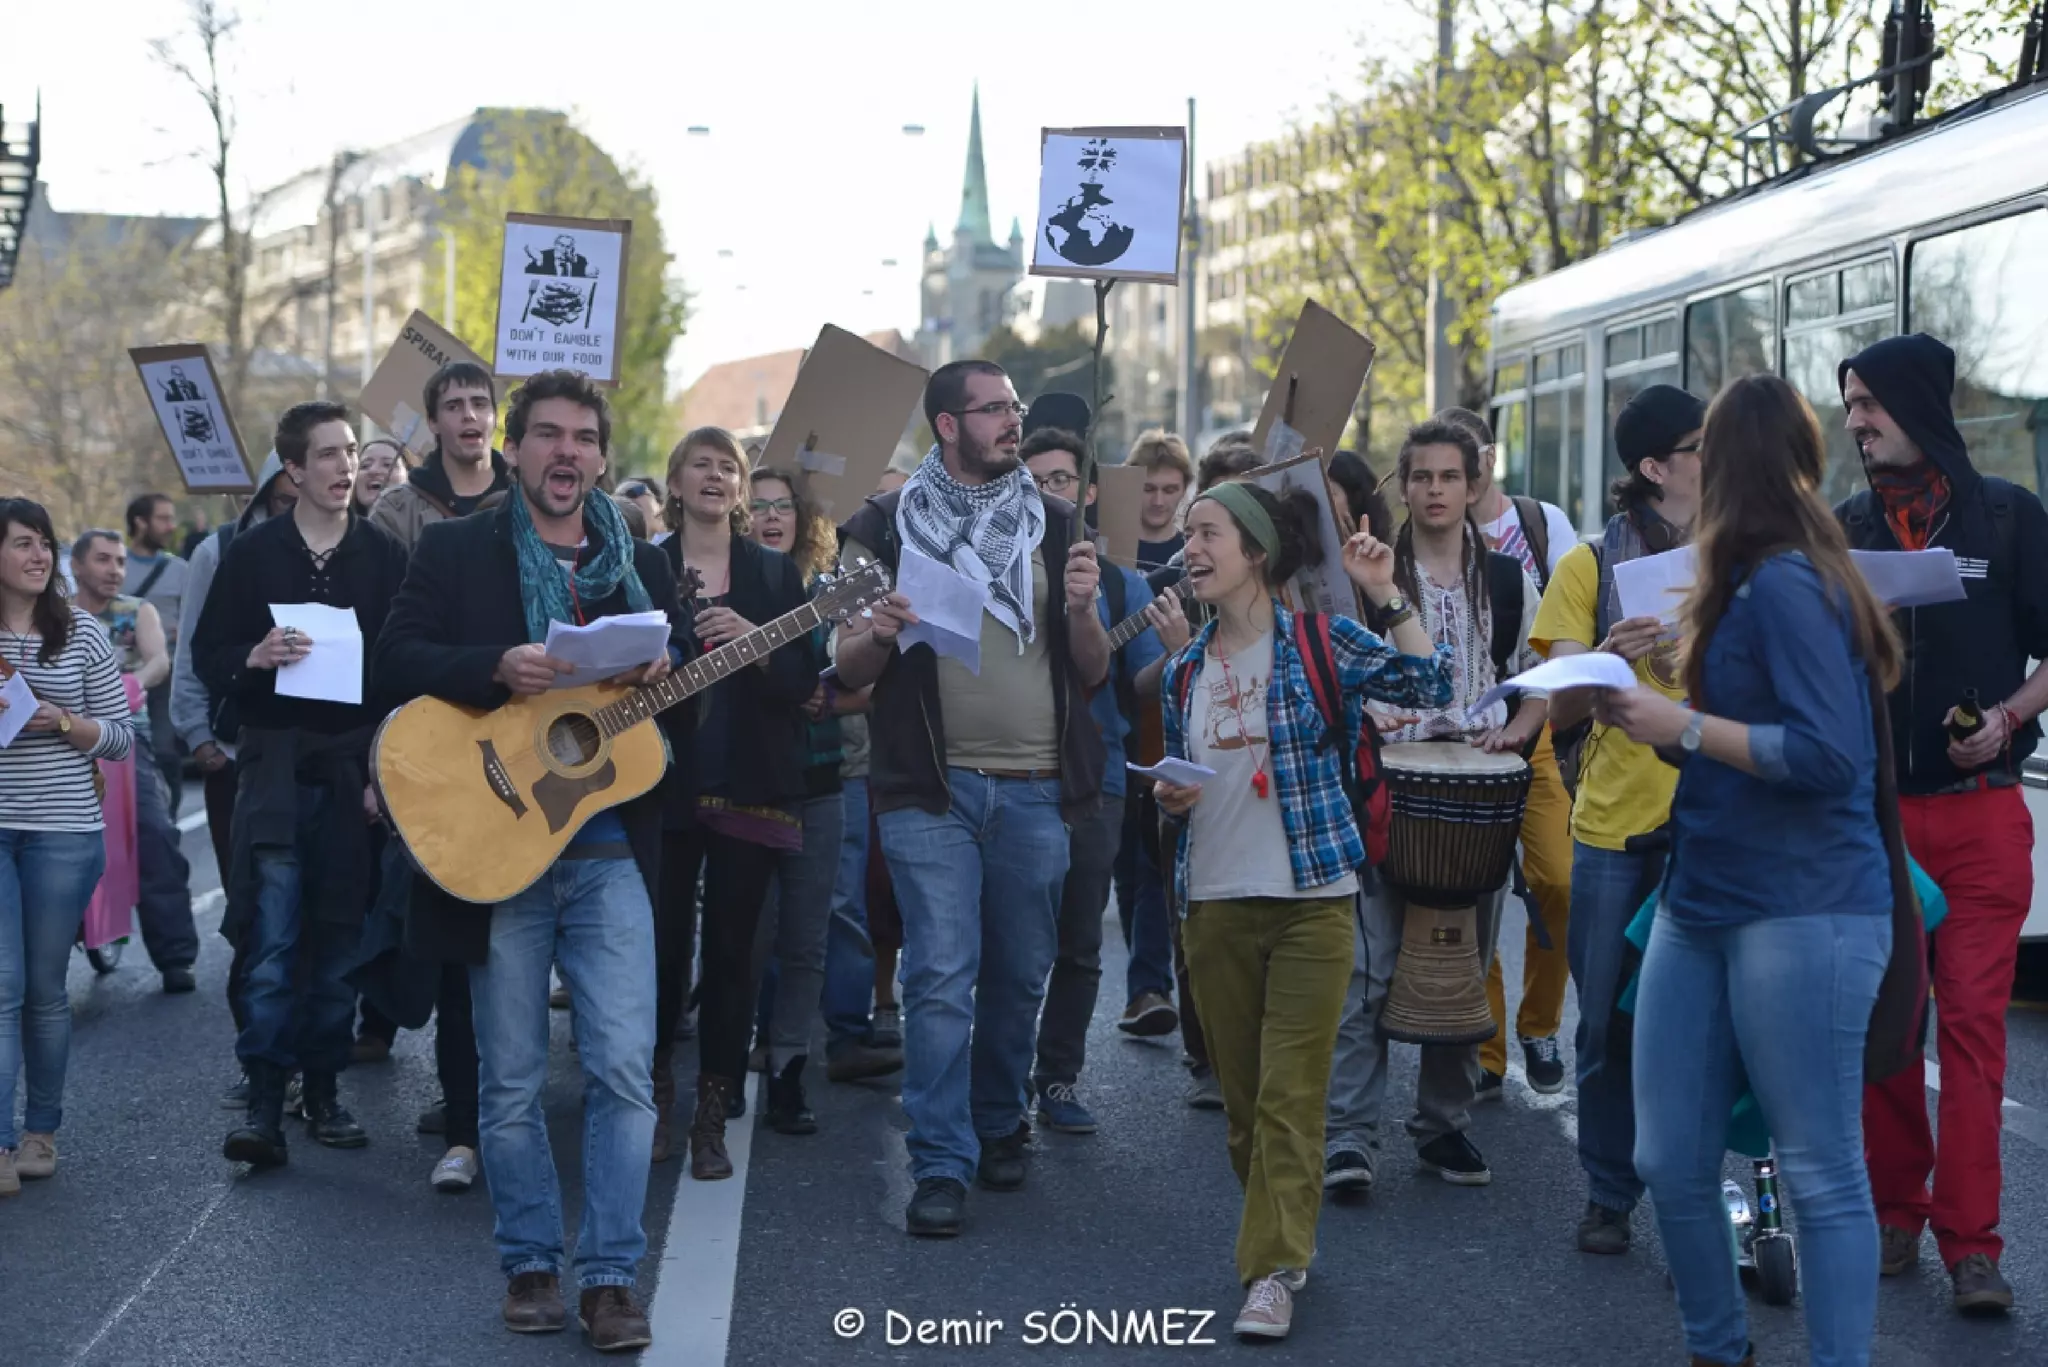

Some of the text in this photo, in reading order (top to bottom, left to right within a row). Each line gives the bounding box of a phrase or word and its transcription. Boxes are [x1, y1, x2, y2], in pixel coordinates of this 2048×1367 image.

[510, 327, 602, 347] DON'T GAMBLE
[506, 348, 603, 365] WITH OUR FOOD
